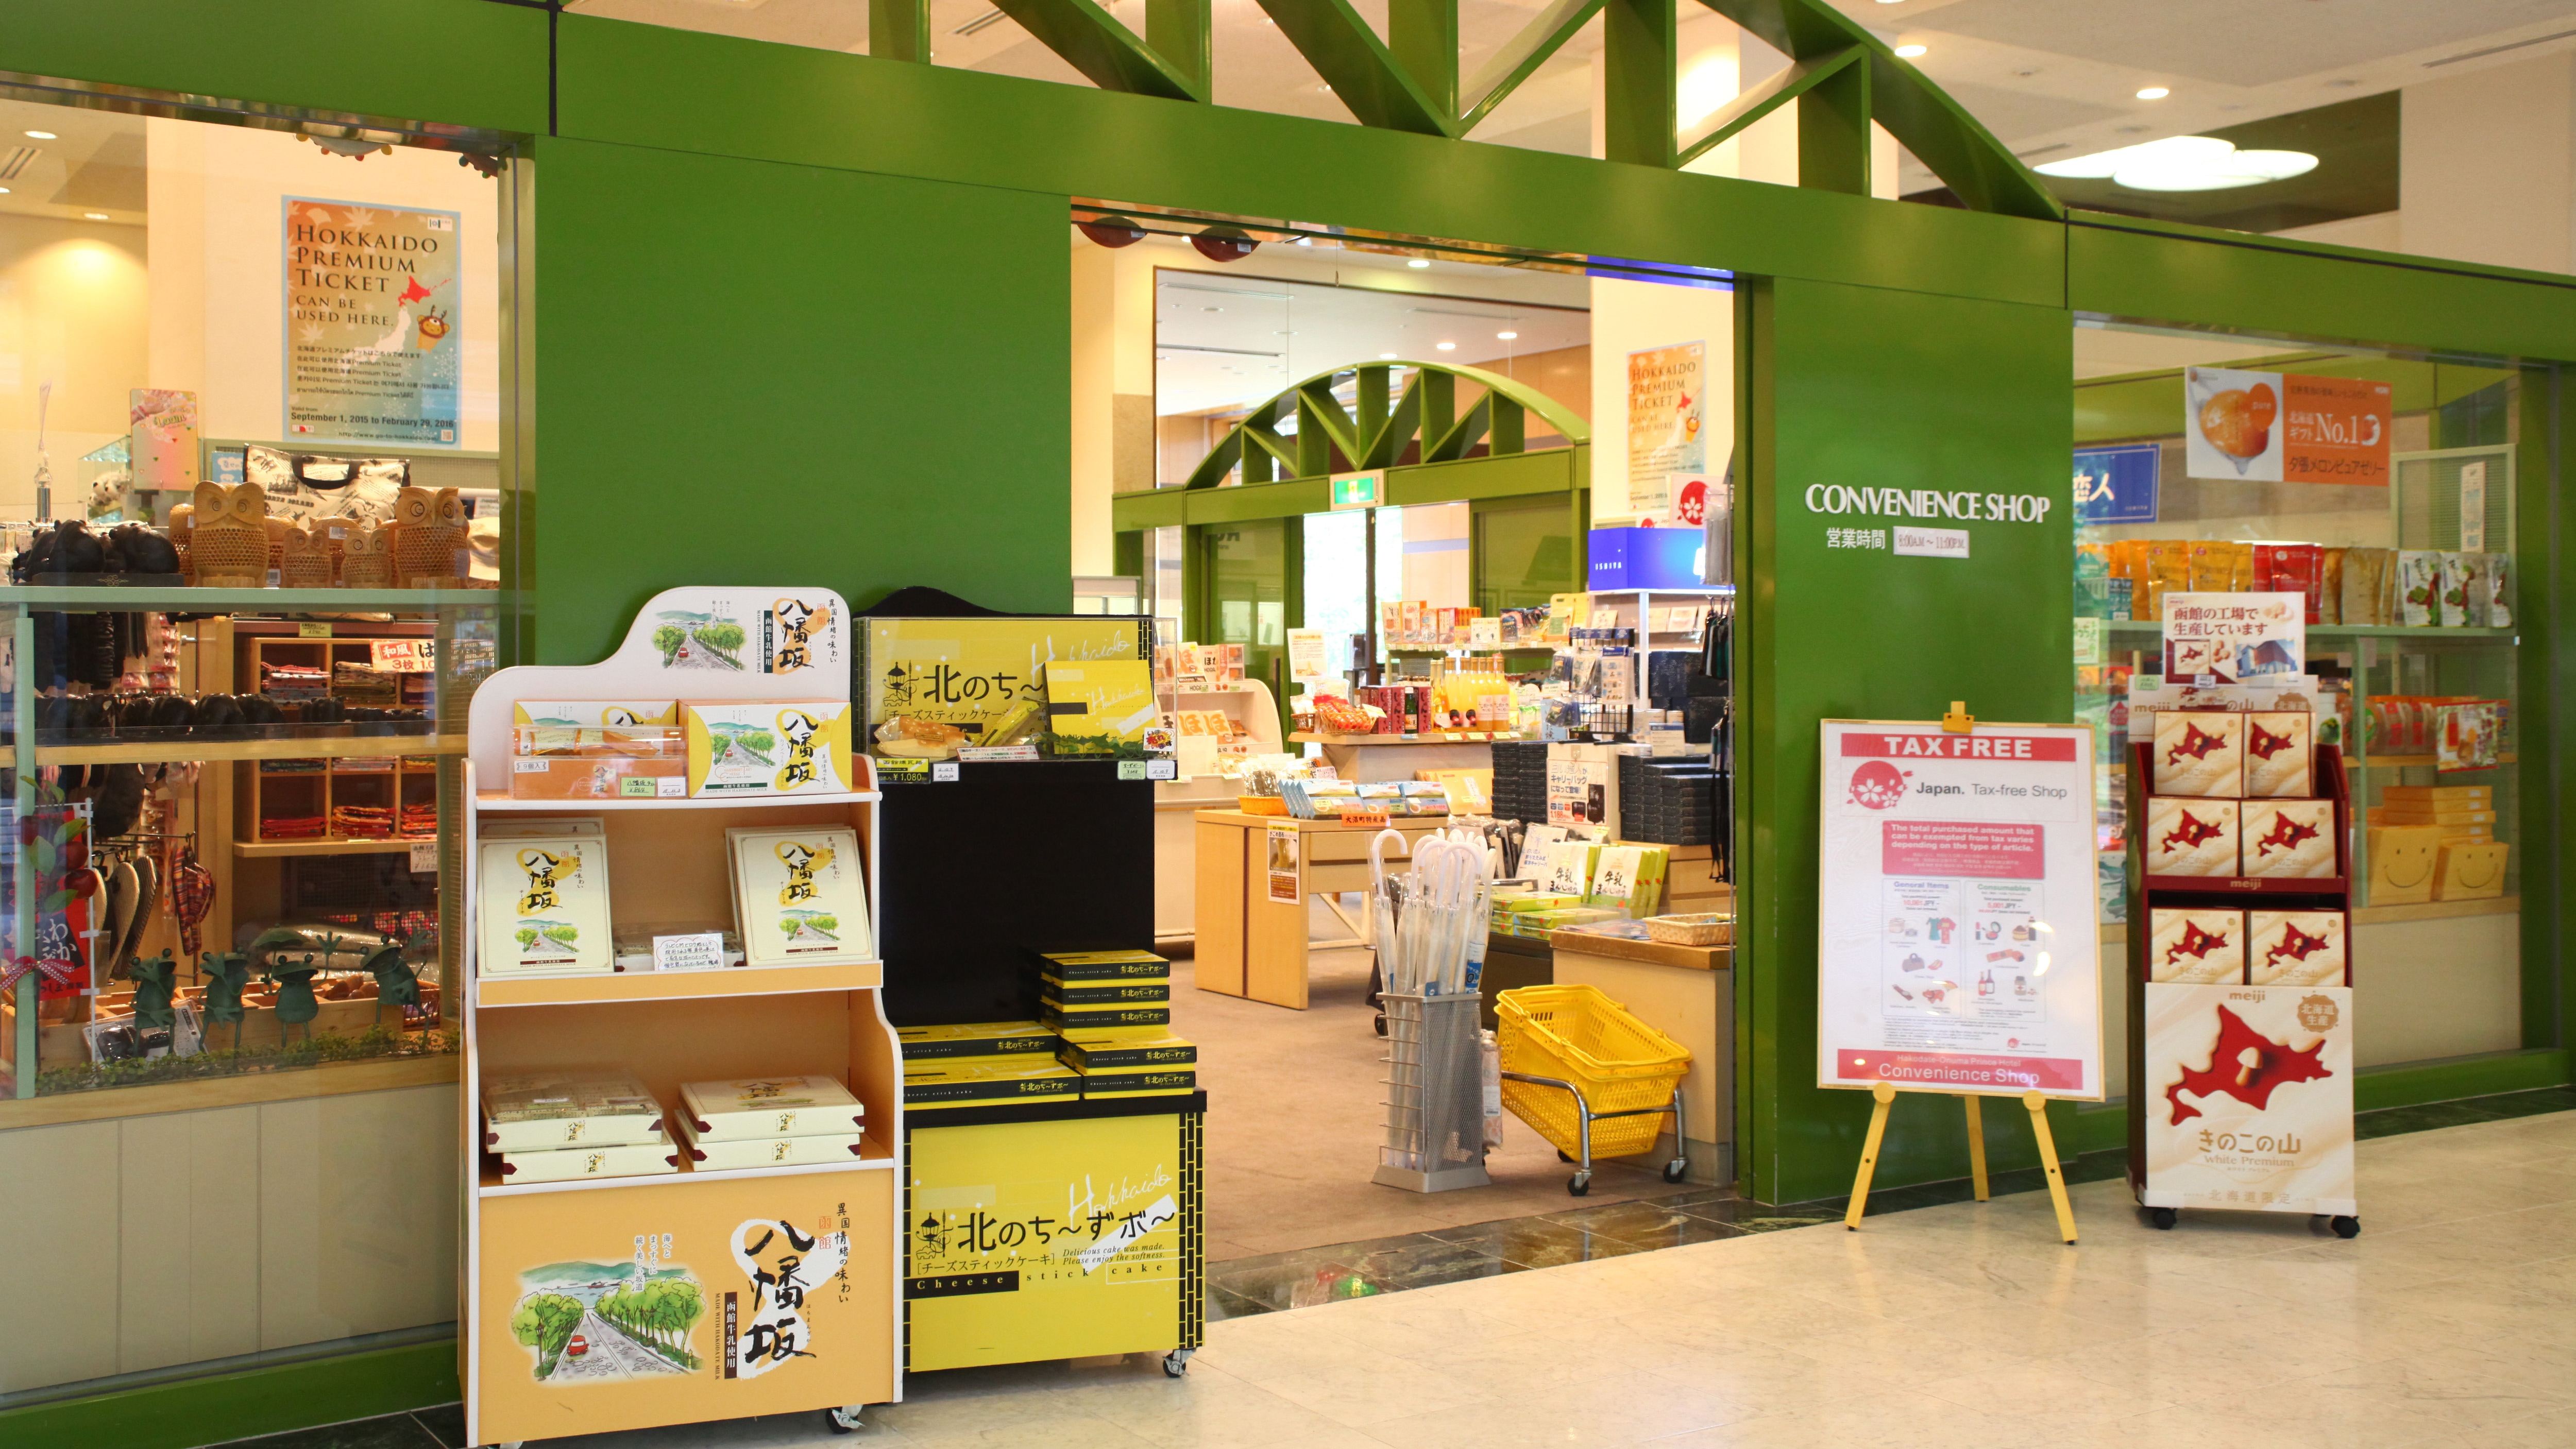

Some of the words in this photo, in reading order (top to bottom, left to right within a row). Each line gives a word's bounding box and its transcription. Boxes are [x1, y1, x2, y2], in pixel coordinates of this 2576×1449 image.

[296, 224, 437, 253] HOKKAIDO
[297, 246, 415, 273] PREMIUM
[296, 268, 389, 292] TICKET
[296, 295, 330, 308] CAN
[339, 299, 356, 309] BE
[297, 310, 340, 323] USED
[348, 314, 393, 327] HERE.
[352, 368, 381, 377] Premium
[1633, 362, 1696, 380] HOKKAIDO
[1633, 379, 1685, 396] PREMIUM
[1633, 396, 1673, 410] TICKET
[291, 412, 336, 423] September
[350, 416, 368, 424] 2015
[382, 417, 417, 428] February
[420, 419, 432, 428] 29,
[435, 420, 453, 428] 2016
[2290, 411, 2314, 425] 北海道
[2290, 428, 2313, 440] ギフト
[2316, 413, 2358, 444] No.1
[1805, 483, 1981, 520] CONVENIENCE
[1985, 492, 2050, 523] SHOP
[1827, 527, 1886, 549] 営業時間
[2174, 607, 2259, 620] 函館の工場で
[778, 599, 815, 669] 八幡坂
[827, 599, 838, 663] 異国情緒の味わい
[2173, 622, 2267, 636] 生産しています
[382, 643, 411, 659] 和風
[393, 659, 414, 670] 3枚
[1178, 714, 1204, 733] ほ
[1203, 714, 1229, 734] ほ
[785, 715, 820, 782] 八幡坂
[1884, 737, 1943, 756] TAX
[1953, 737, 2032, 758] FREE
[1551, 775, 1587, 784] キャリーバッグ
[1917, 782, 1964, 796] Japan.
[1972, 783, 2026, 797] Tax-free
[2032, 786, 2067, 800] Shop
[525, 853, 563, 909] 八幡坂
[783, 845, 822, 899] 八幡坂
[1556, 867, 1572, 882] 牛乳
[1605, 871, 1623, 886] 牛乳
[2230, 879, 2261, 890] meiji
[2229, 990, 2265, 1003] meiji
[2301, 1004, 2334, 1015] 北海道
[2307, 1015, 2329, 1026] 生産
[1897, 1054, 1969, 1065] Hakodate-Onuma
[1971, 1057, 1997, 1066] Prince
[1999, 1059, 2021, 1067] Hotel
[1879, 1063, 1990, 1082] Convenience
[1995, 1068, 2040, 1085] Shop
[2199, 1129, 2301, 1154] きのこの山
[2204, 1154, 2236, 1164] White
[2242, 1156, 2294, 1167] Premium
[1069, 1163, 1172, 1233] Hokkaido
[2209, 1189, 2291, 1204] 北海道限定
[958, 1211, 1175, 1253] 北のち～ずボ～
[663, 1233, 672, 1258] 海へと
[835, 1203, 851, 1303] 異国情緒の味わい
[1063, 1249, 1100, 1257] Delicious
[1103, 1246, 1121, 1254] cake
[635, 1236, 644, 1291] 続く美しい坂道
[649, 1235, 657, 1275] まっすぐに
[1063, 1257, 1089, 1265] Please
[1092, 1255, 1113, 1263] enjoy
[1132, 1252, 1164, 1260] softness.
[917, 1275, 1004, 1289] Cheese
[1027, 1268, 1089, 1282] stick
[1111, 1264, 1162, 1275] cake
[744, 1220, 817, 1363] 八幡坂
[726, 1301, 736, 1368] 函館牛乳使用
